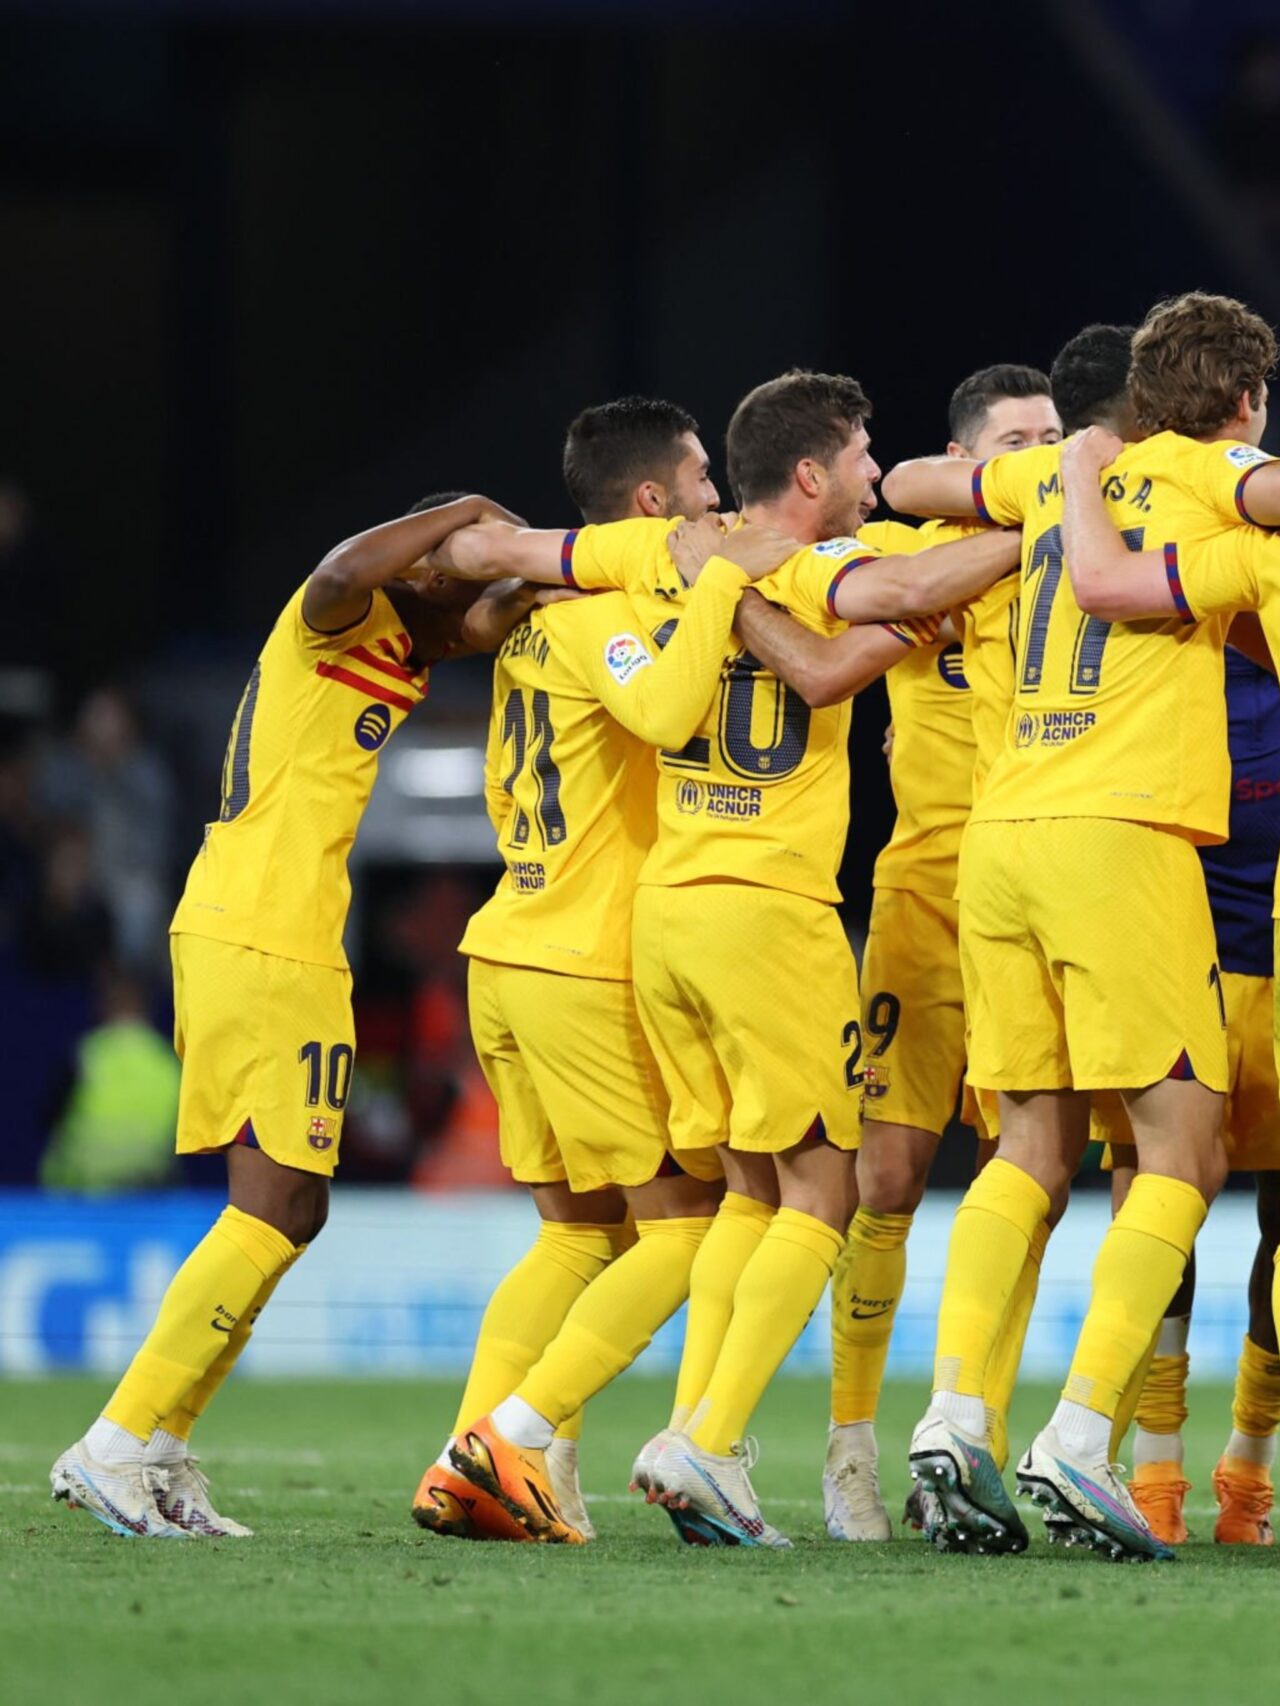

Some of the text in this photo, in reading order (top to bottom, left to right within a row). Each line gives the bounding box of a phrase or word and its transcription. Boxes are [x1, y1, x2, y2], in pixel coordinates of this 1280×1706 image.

[1043, 711, 1096, 727] UNHCR
[501, 687, 567, 852] 11
[706, 798, 761, 816] ACNUR
[707, 783, 762, 803] UNHCR
[865, 991, 902, 1059] 9
[298, 1040, 355, 1112] 10
